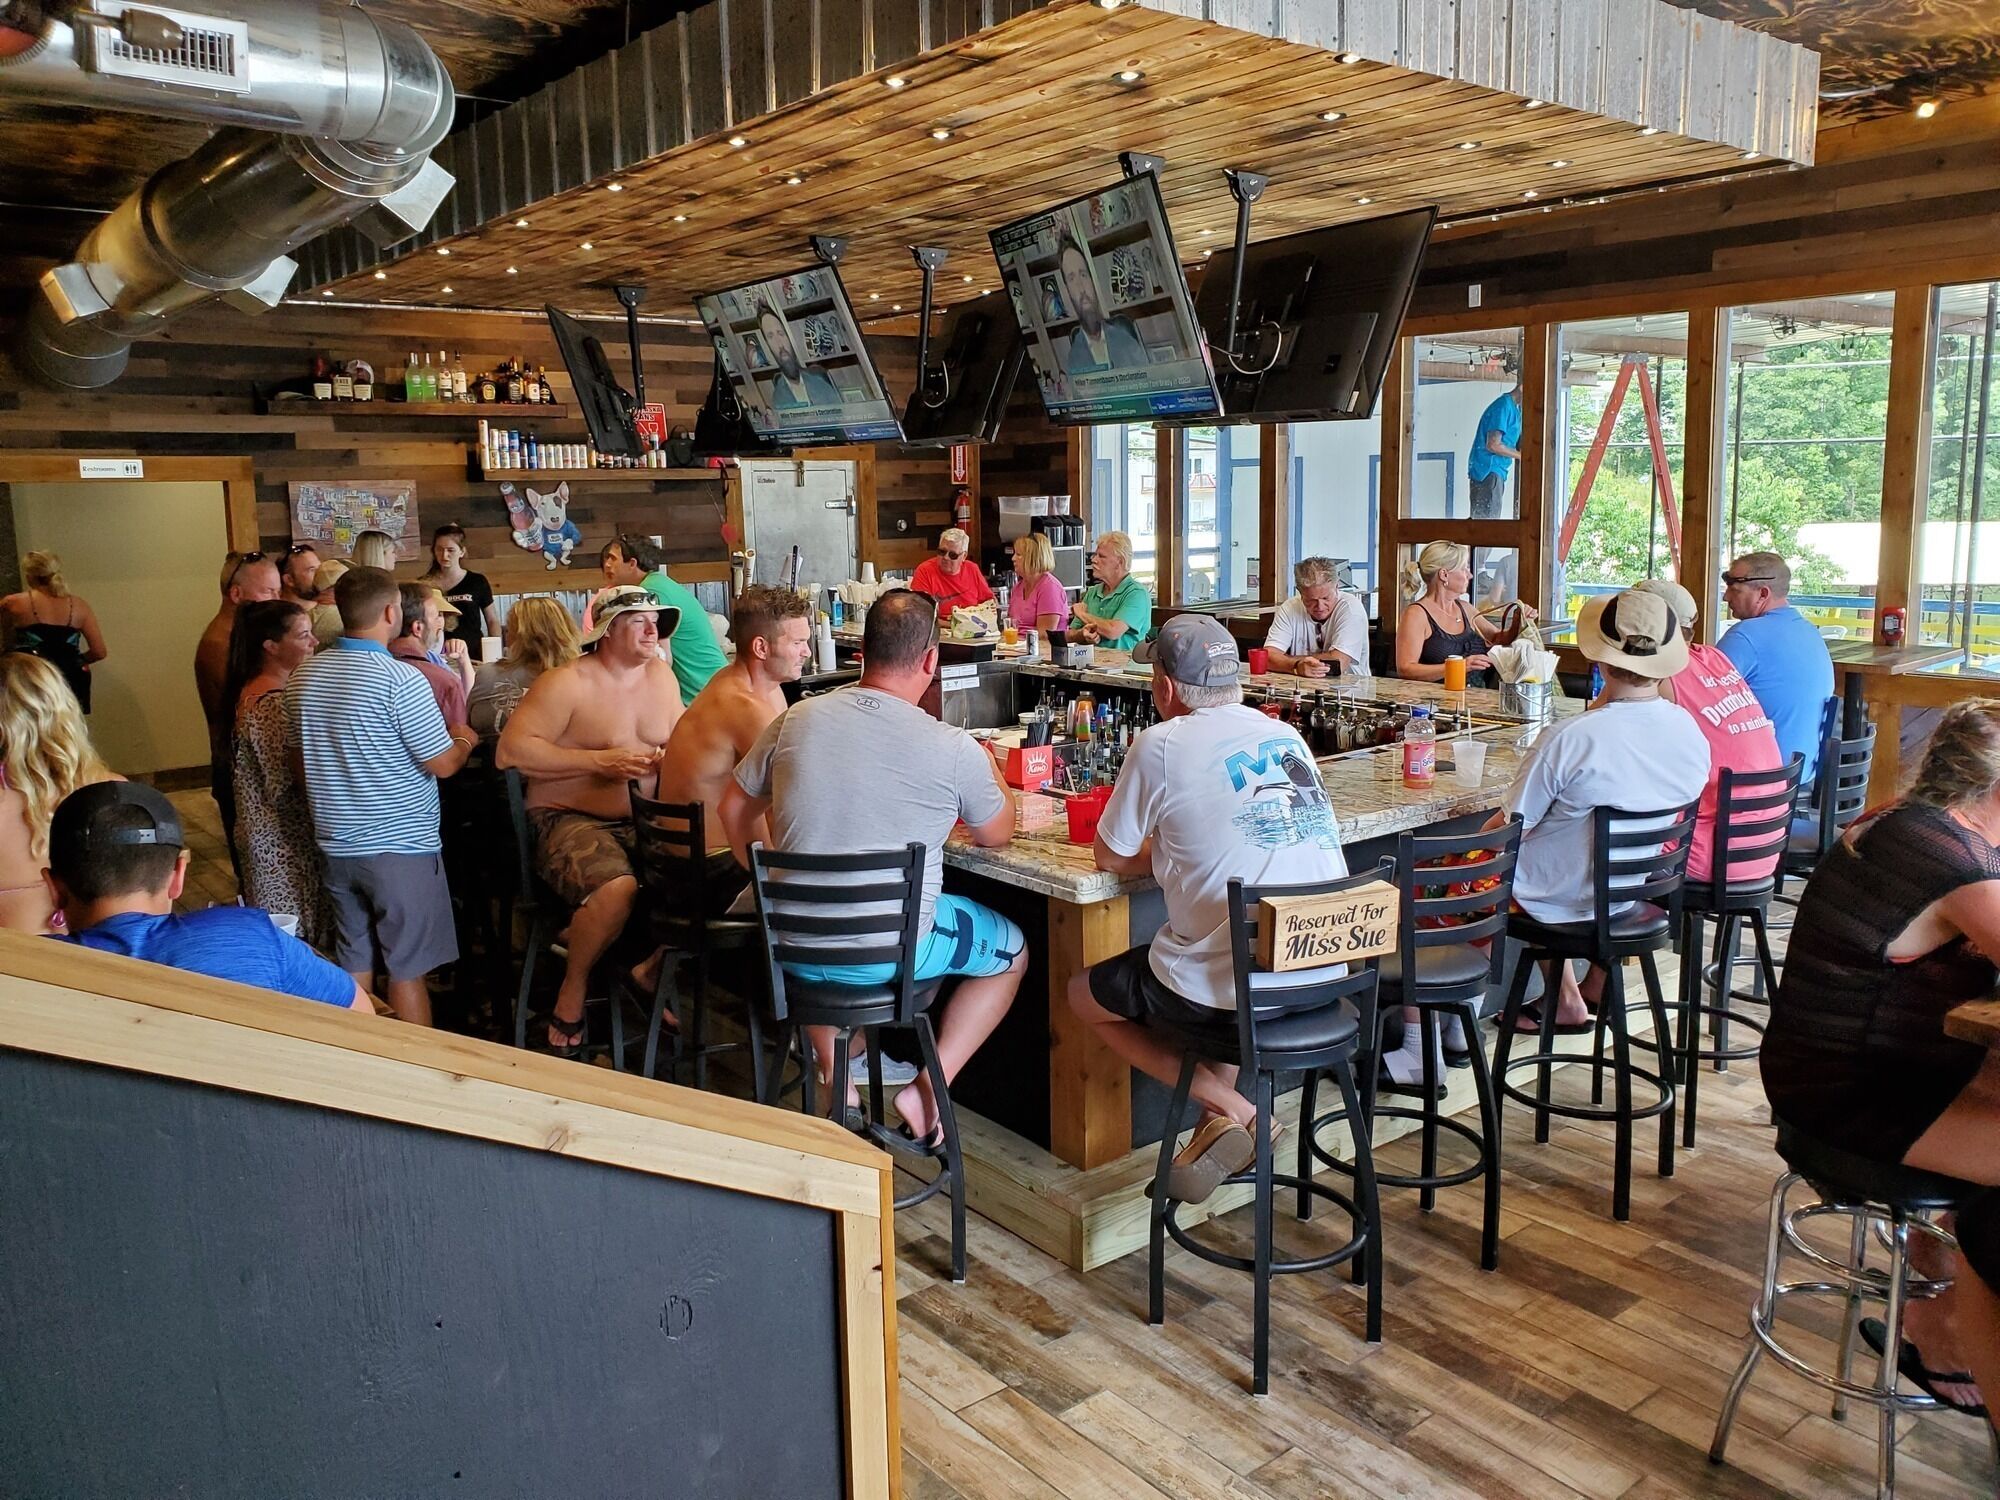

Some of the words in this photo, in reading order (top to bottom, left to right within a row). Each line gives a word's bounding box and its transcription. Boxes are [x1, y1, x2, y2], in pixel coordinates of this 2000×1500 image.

[1074, 649, 1088, 657] SKYY
[1286, 905, 1358, 933] Reserved
[1360, 903, 1389, 921] For
[1285, 933, 1342, 961] Miss
[1346, 925, 1388, 951] Sue
